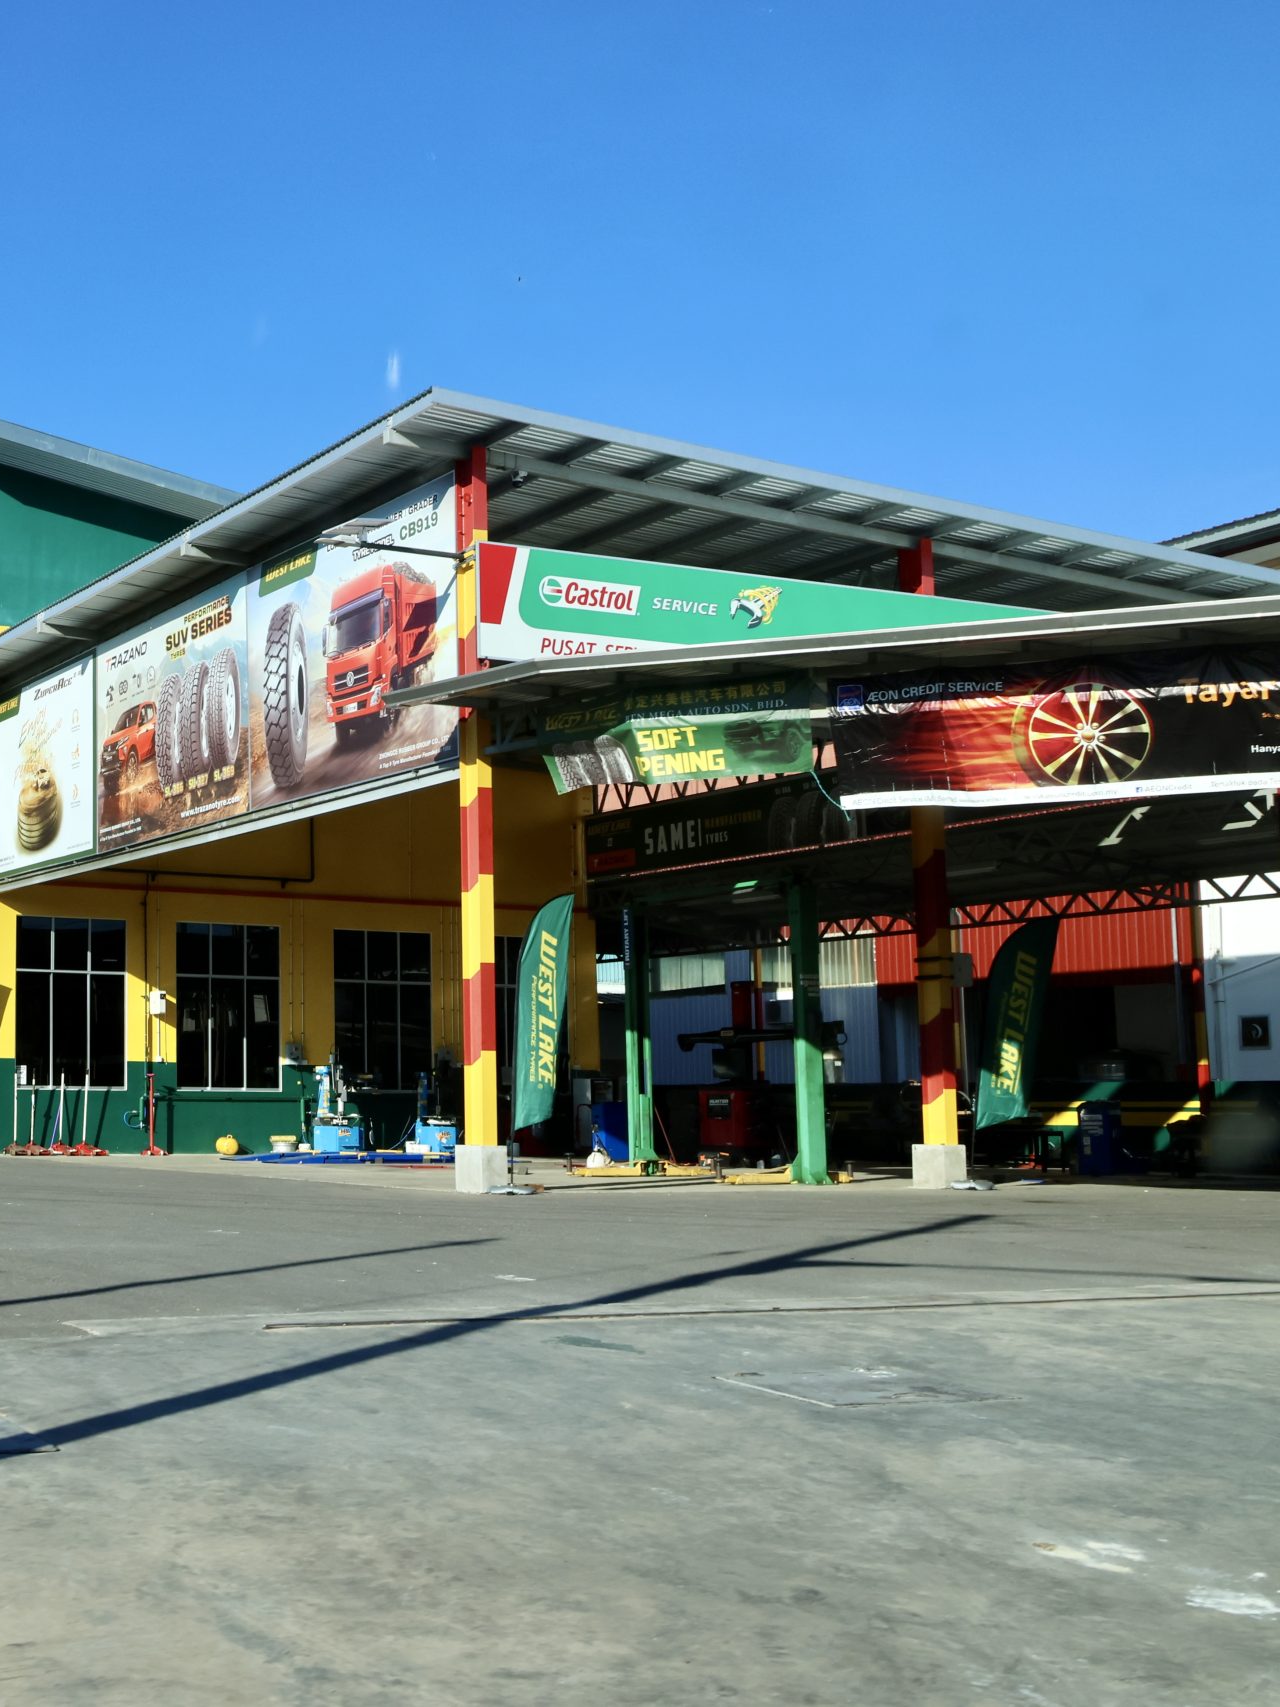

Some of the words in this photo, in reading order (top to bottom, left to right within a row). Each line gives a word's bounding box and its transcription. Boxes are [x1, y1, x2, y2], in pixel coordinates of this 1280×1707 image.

[408, 494, 438, 515] GRADER
[399, 511, 438, 540] CB919
[184, 595, 230, 624] PERFORMANCE
[564, 581, 634, 612] Castrol
[652, 597, 718, 616] SERVICE
[165, 627, 189, 651] SUV
[191, 607, 232, 639] SERIES
[105, 641, 148, 672] TRAZANO
[541, 637, 597, 656] PUSAT
[901, 682, 945, 698] CREDIT
[948, 681, 1004, 693] SERVICE
[687, 705, 721, 717] AUTO
[724, 702, 753, 713] SDN.
[757, 699, 788, 710] BHD.
[636, 726, 699, 752] SOFT
[635, 748, 726, 776] PENING
[180, 796, 241, 818] www.trazanotyre.com
[644, 818, 696, 855] SAME
[538, 930, 558, 1019] WEST
[1007, 949, 1038, 1031] WEST
[538, 1015, 558, 1089] LAKE
[997, 1027, 1025, 1096] LAKE
